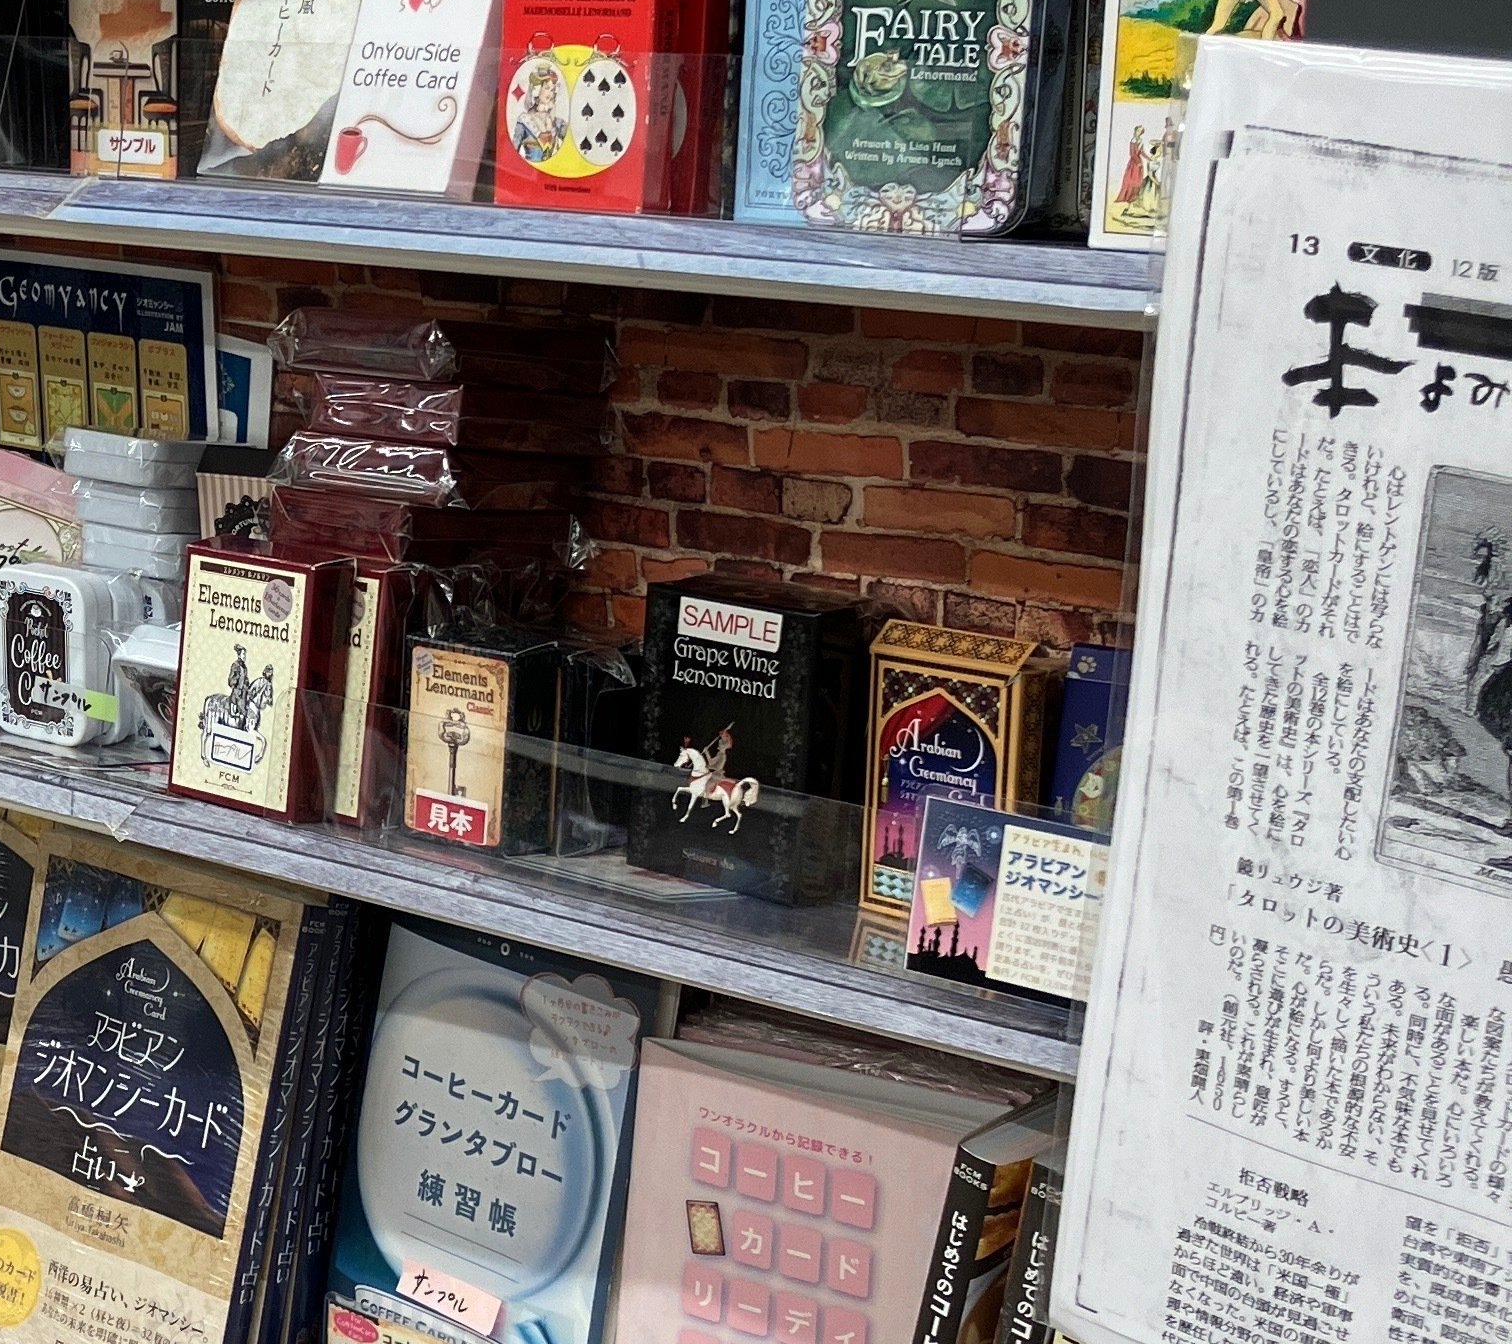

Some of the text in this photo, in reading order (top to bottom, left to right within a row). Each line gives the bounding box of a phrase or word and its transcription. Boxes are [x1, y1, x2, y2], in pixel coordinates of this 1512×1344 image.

[362, 41, 461, 64] OnYourSide
[848, 6, 985, 68] FAIRY
[914, 42, 980, 68] TALE
[353, 68, 458, 91] Coffee Card
[109, 135, 156, 154] サンプル
[1289, 233, 1320, 257] 13
[1358, 244, 1418, 269] 文化
[197, 584, 263, 614] Elements
[209, 608, 290, 643] Lenormand
[682, 604, 779, 646] SAMPLE
[432, 664, 488, 688] Elements
[673, 638, 780, 676] Grape Wine
[425, 677, 494, 705] Lenormand
[672, 660, 777, 699] Lenormand
[890, 719, 962, 761] Arabian
[428, 802, 473, 838] 見本
[1008, 850, 1087, 880] アラビアン
[1236, 856, 1344, 903] 鏡リュウジ著
[86, 1010, 186, 1073] アラビアン
[33, 1039, 229, 1151] ジオマンシーカード
[401, 1052, 573, 1141] コーヒーカード
[71, 1136, 117, 1184] 占い
[394, 1099, 564, 1185] グランタブロー
[697, 1145, 868, 1208] コーヒー
[1237, 1166, 1311, 1209] 拒否戦略
[67, 1194, 131, 1235] 高橋桐矢
[416, 1169, 518, 1238] 練習帳
[737, 1224, 862, 1282] カード
[412, 1268, 469, 1314] サンプル
